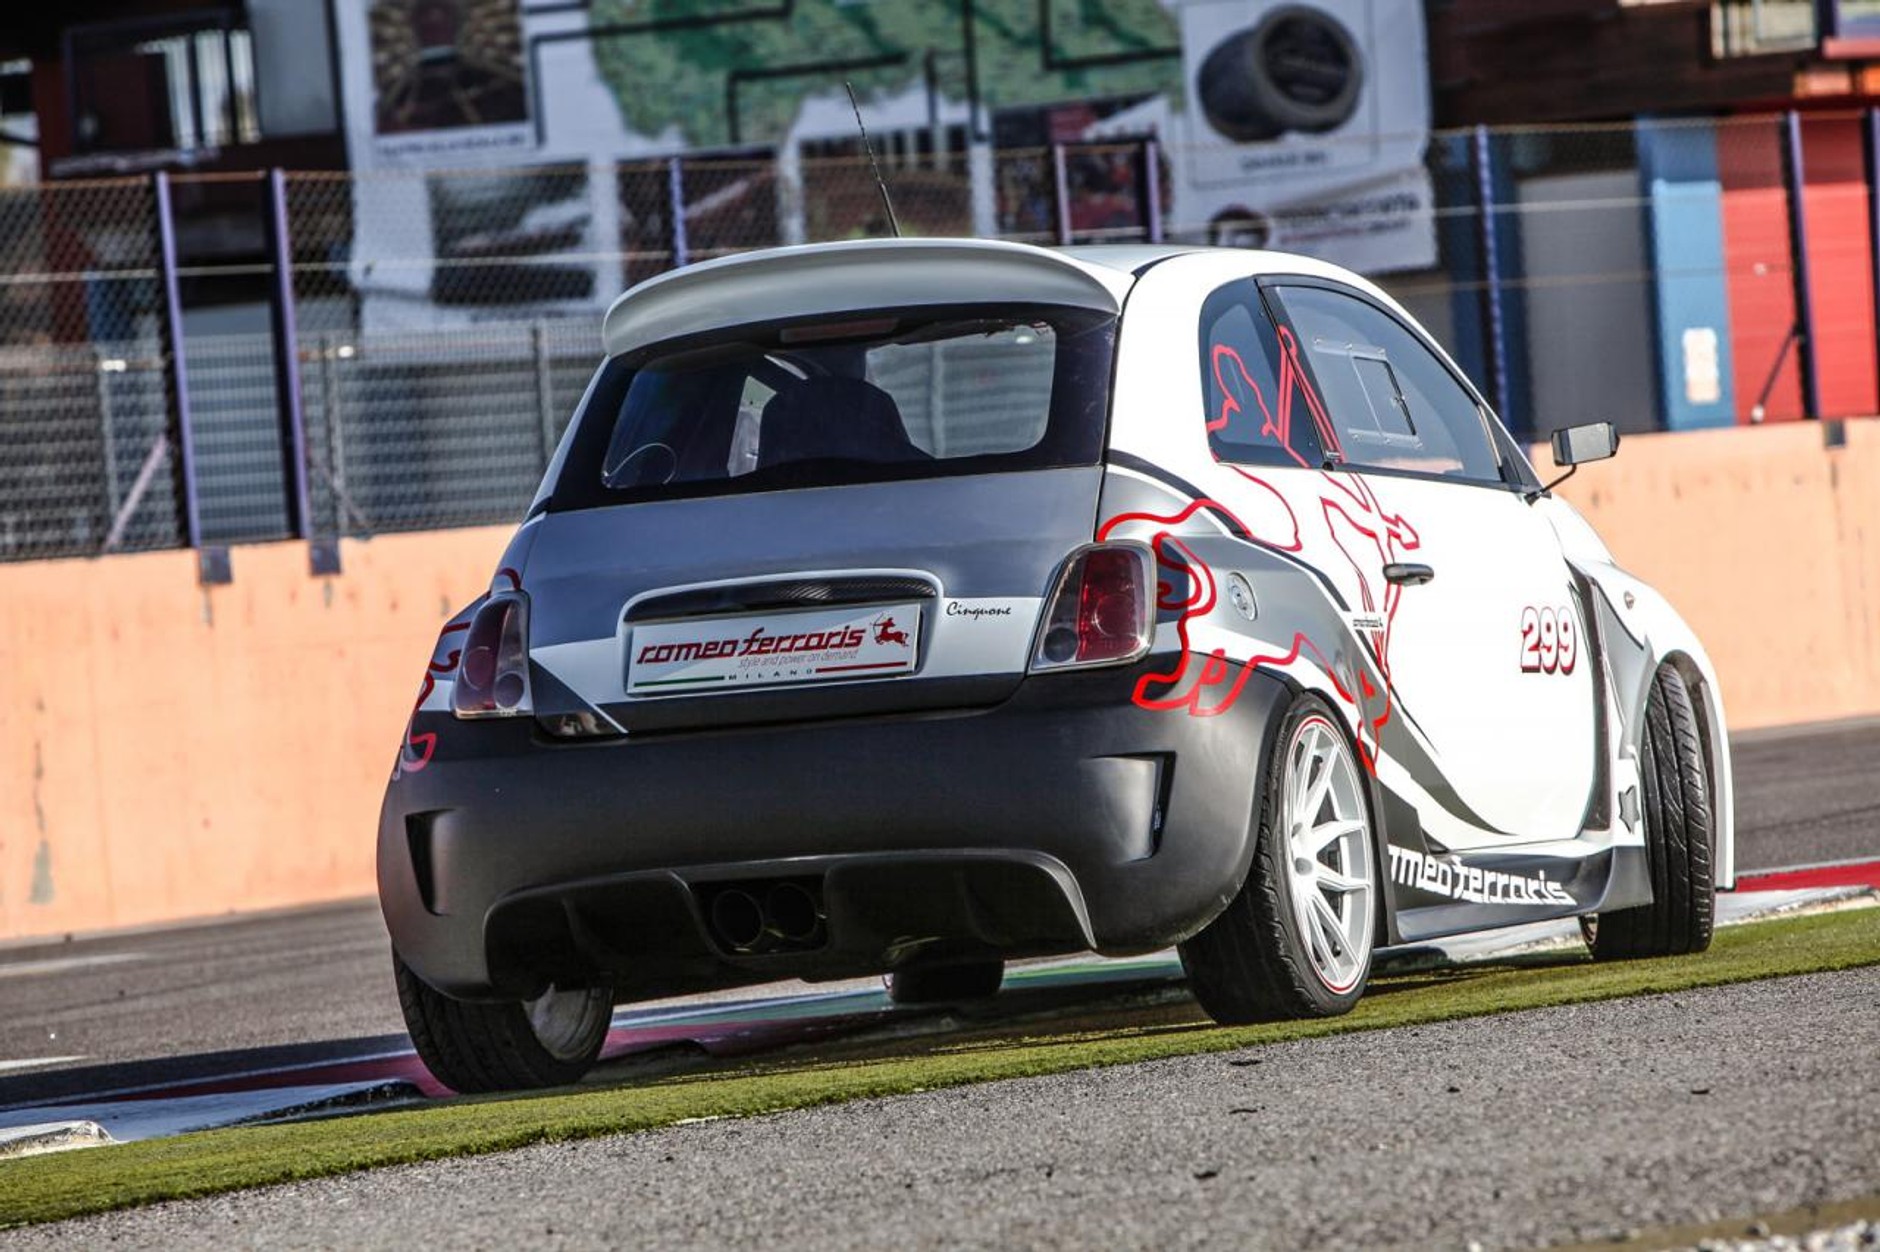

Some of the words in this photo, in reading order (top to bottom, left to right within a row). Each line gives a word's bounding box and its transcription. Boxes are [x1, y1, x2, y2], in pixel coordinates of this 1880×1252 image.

[946, 601, 1012, 620] Cinquone
[636, 638, 739, 664] romeo
[738, 625, 867, 657] ferraris
[1520, 605, 1577, 676] 299
[738, 657, 760, 670] style
[762, 653, 779, 665] and
[779, 654, 807, 667] power
[808, 653, 821, 662] on
[822, 649, 859, 661] demand
[728, 668, 812, 680] MILANO
